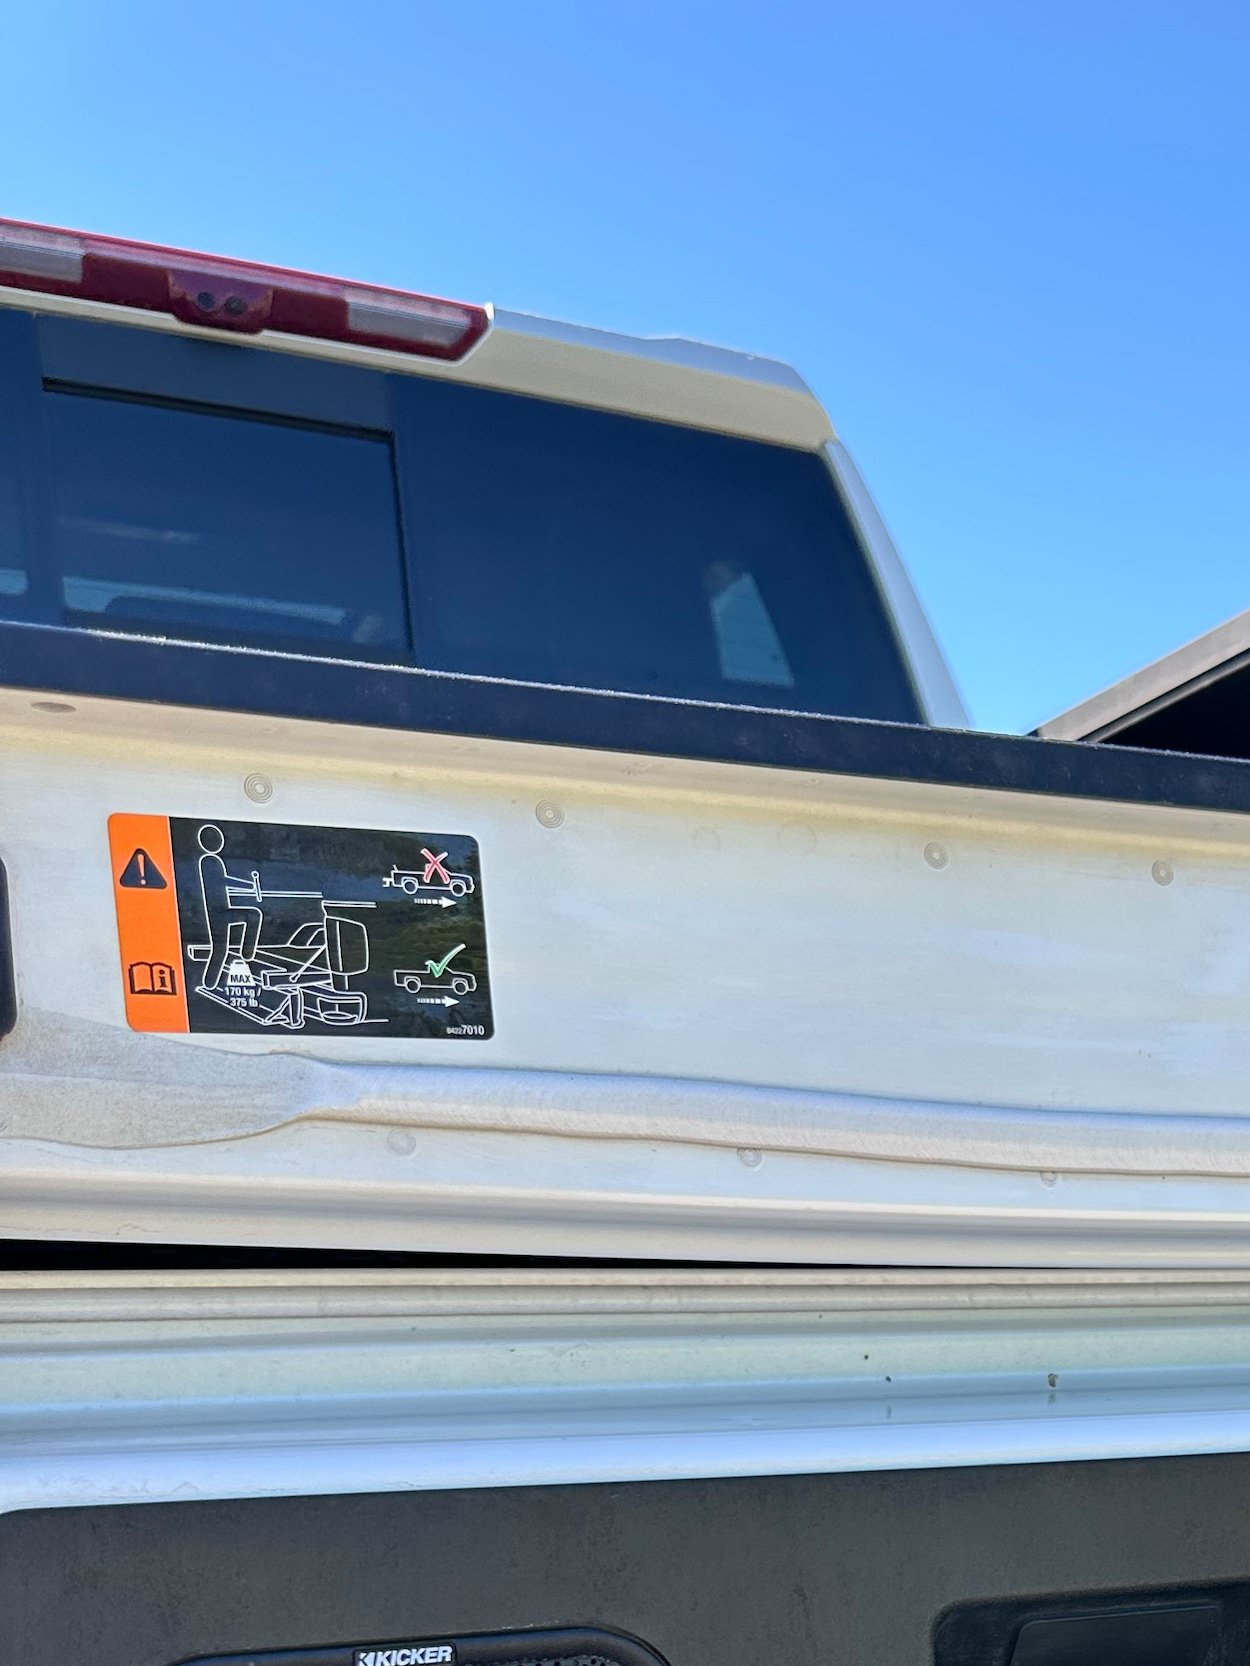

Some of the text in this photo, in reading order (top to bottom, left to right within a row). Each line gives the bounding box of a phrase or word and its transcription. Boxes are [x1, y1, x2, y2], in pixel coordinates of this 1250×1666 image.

[230, 974, 251, 984] MAX
[225, 986, 241, 996] 170
[243, 986, 255, 998] kg
[230, 997, 258, 1007] 375 lb
